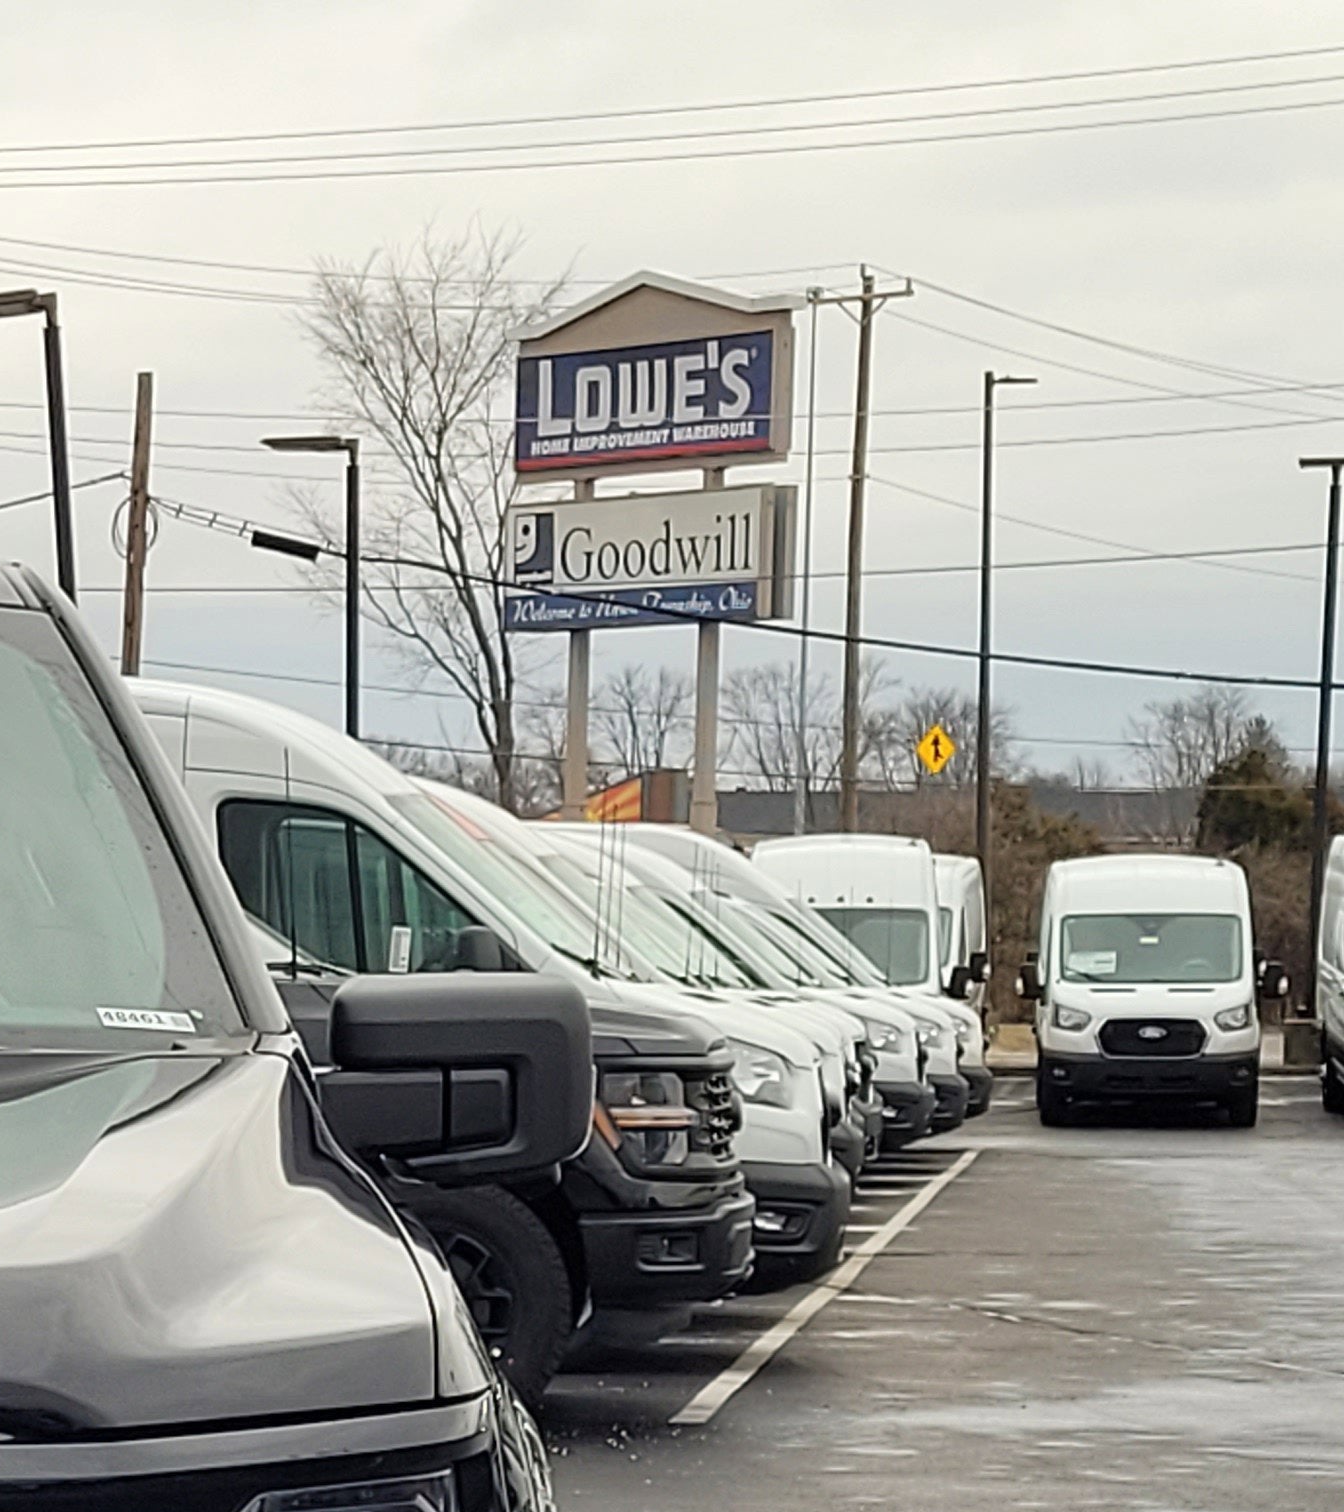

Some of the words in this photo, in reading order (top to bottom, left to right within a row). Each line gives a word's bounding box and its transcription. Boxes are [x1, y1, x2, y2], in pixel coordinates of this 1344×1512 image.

[537, 341, 752, 437] LOWE'S
[531, 437, 570, 456] HOME
[572, 428, 670, 451] IMPROVEMENT
[672, 421, 755, 442] WAREHOUSE
[561, 512, 752, 582] Goodwill
[513, 599, 576, 623] Welcome
[578, 602, 593, 618] to
